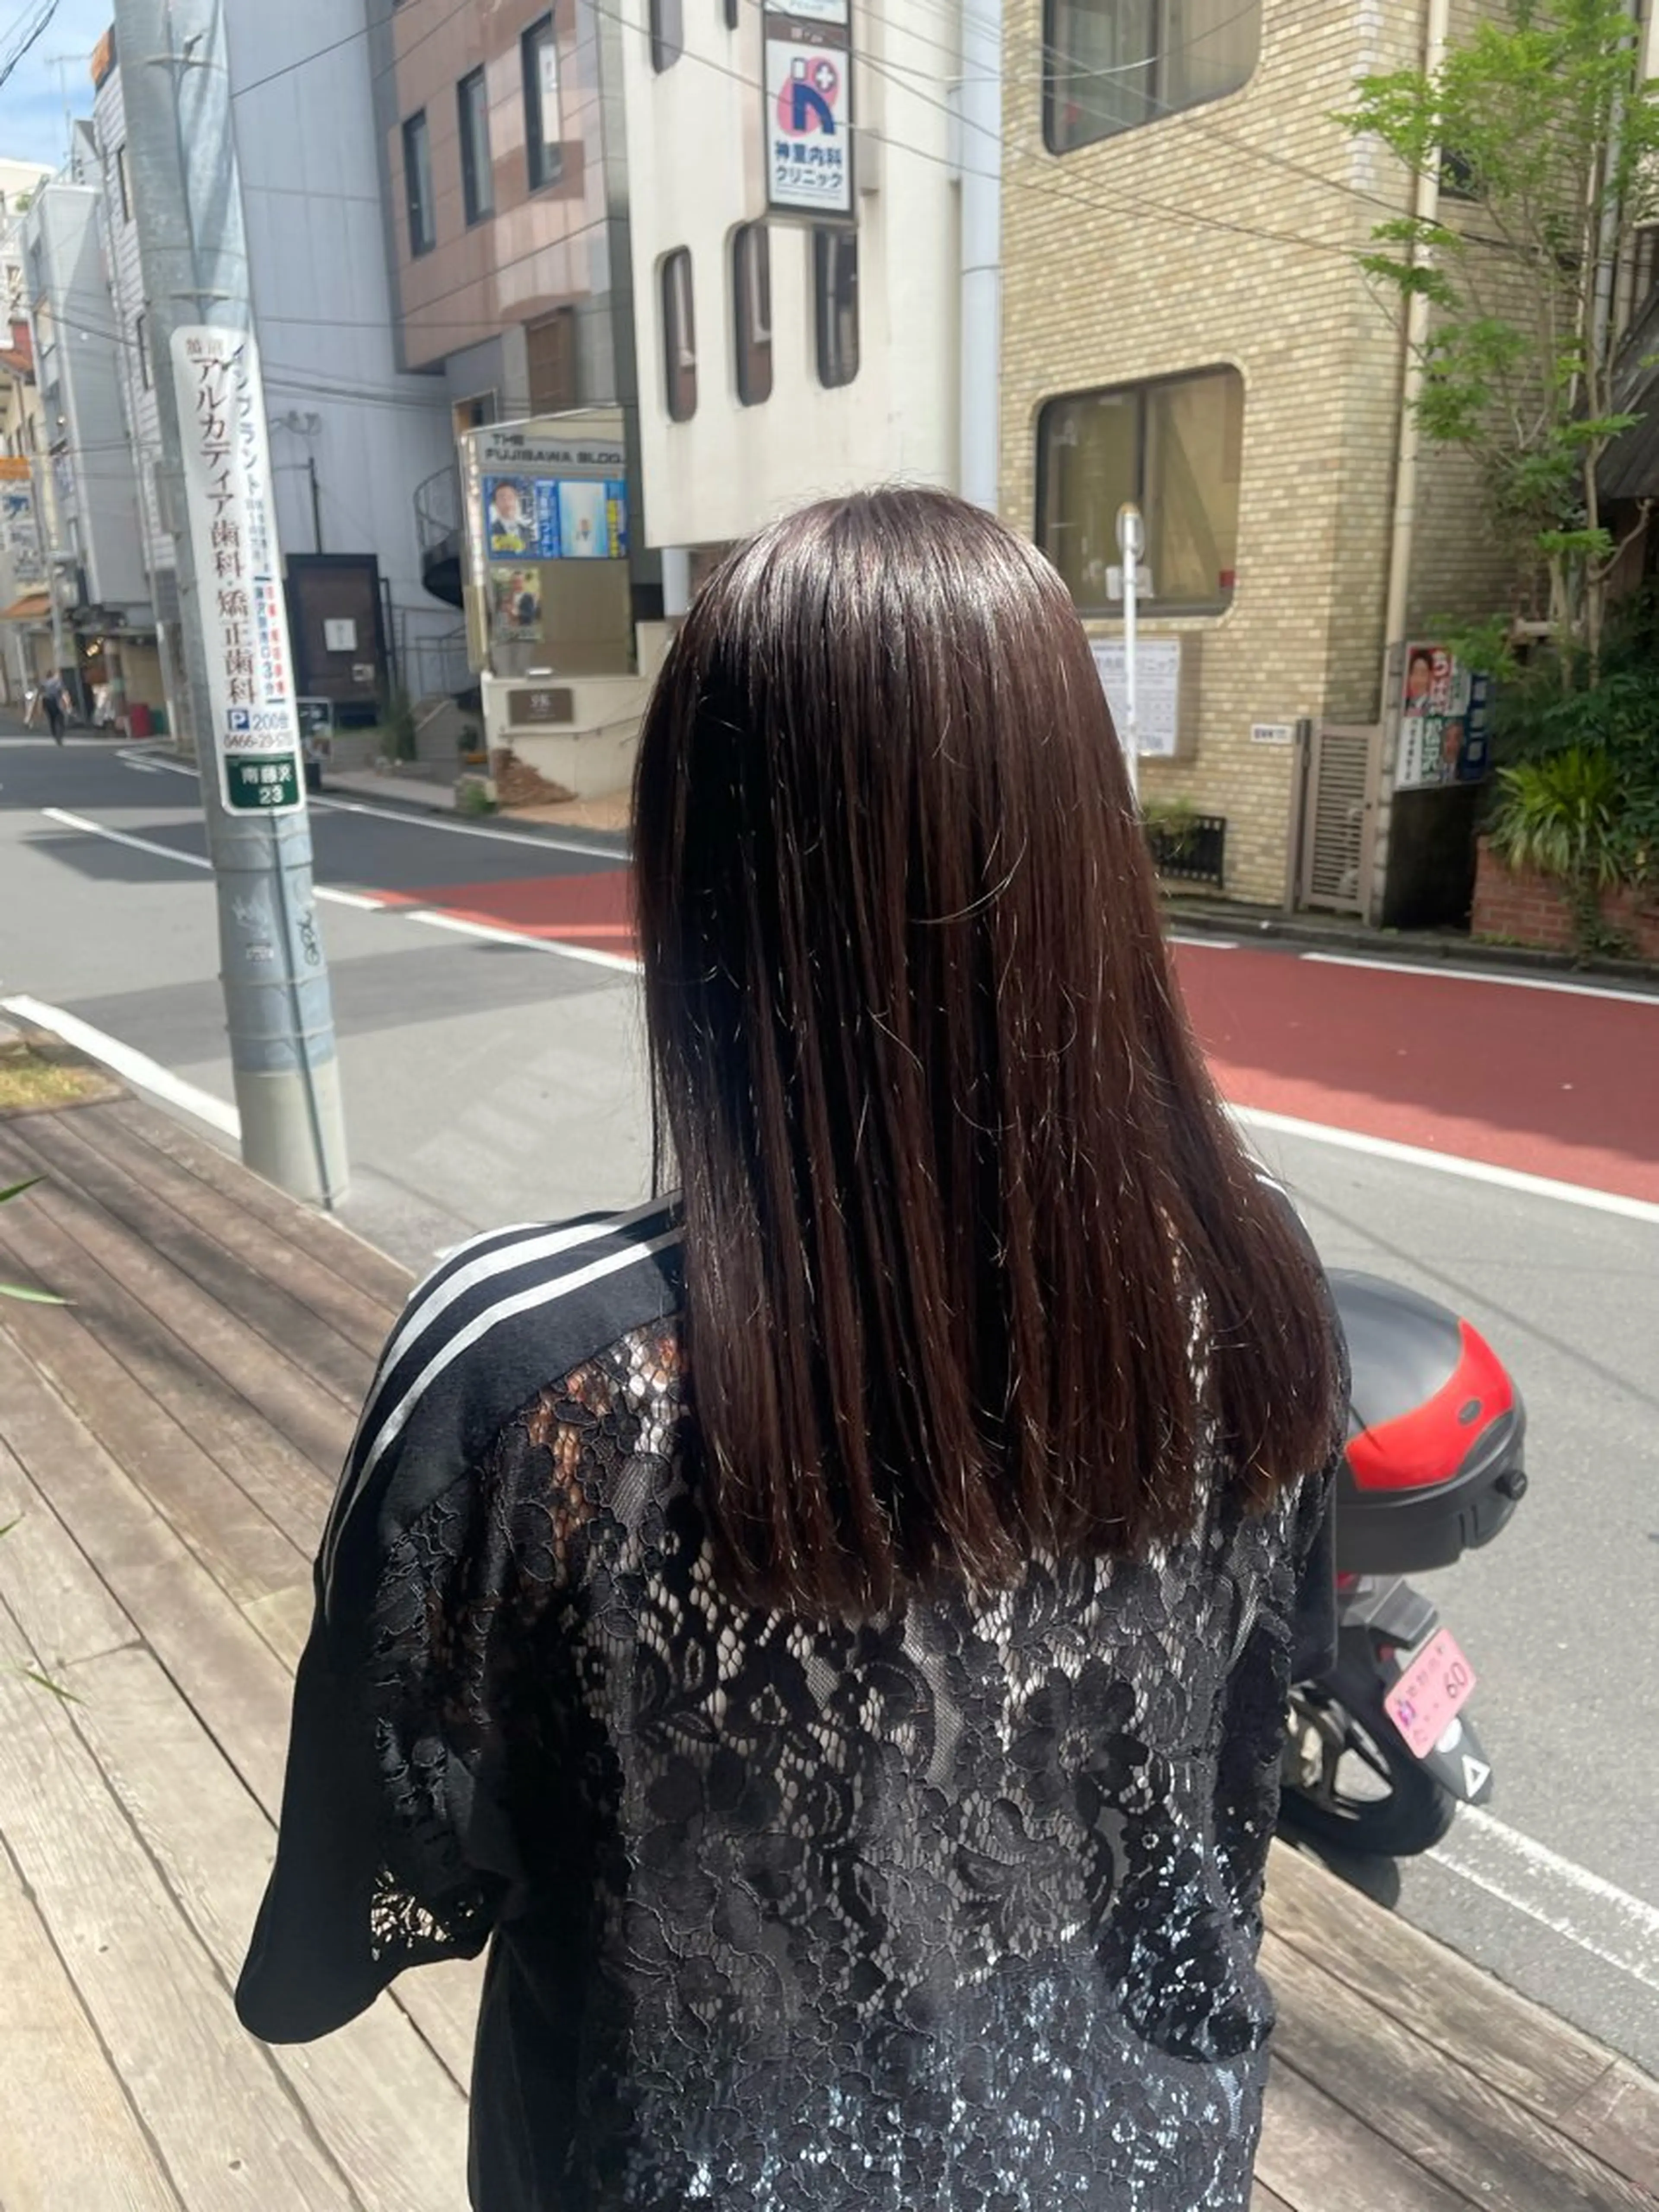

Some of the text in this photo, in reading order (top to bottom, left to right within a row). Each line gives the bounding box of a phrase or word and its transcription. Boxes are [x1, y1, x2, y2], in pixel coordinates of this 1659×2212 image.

[776, 165, 843, 188] クリニック
[491, 433, 524, 447] THE
[485, 448, 574, 463] FUJISAWA
[241, 762, 293, 785] 南藤沢
[258, 784, 285, 805] 23
[1443, 1661, 1468, 1699] 60
